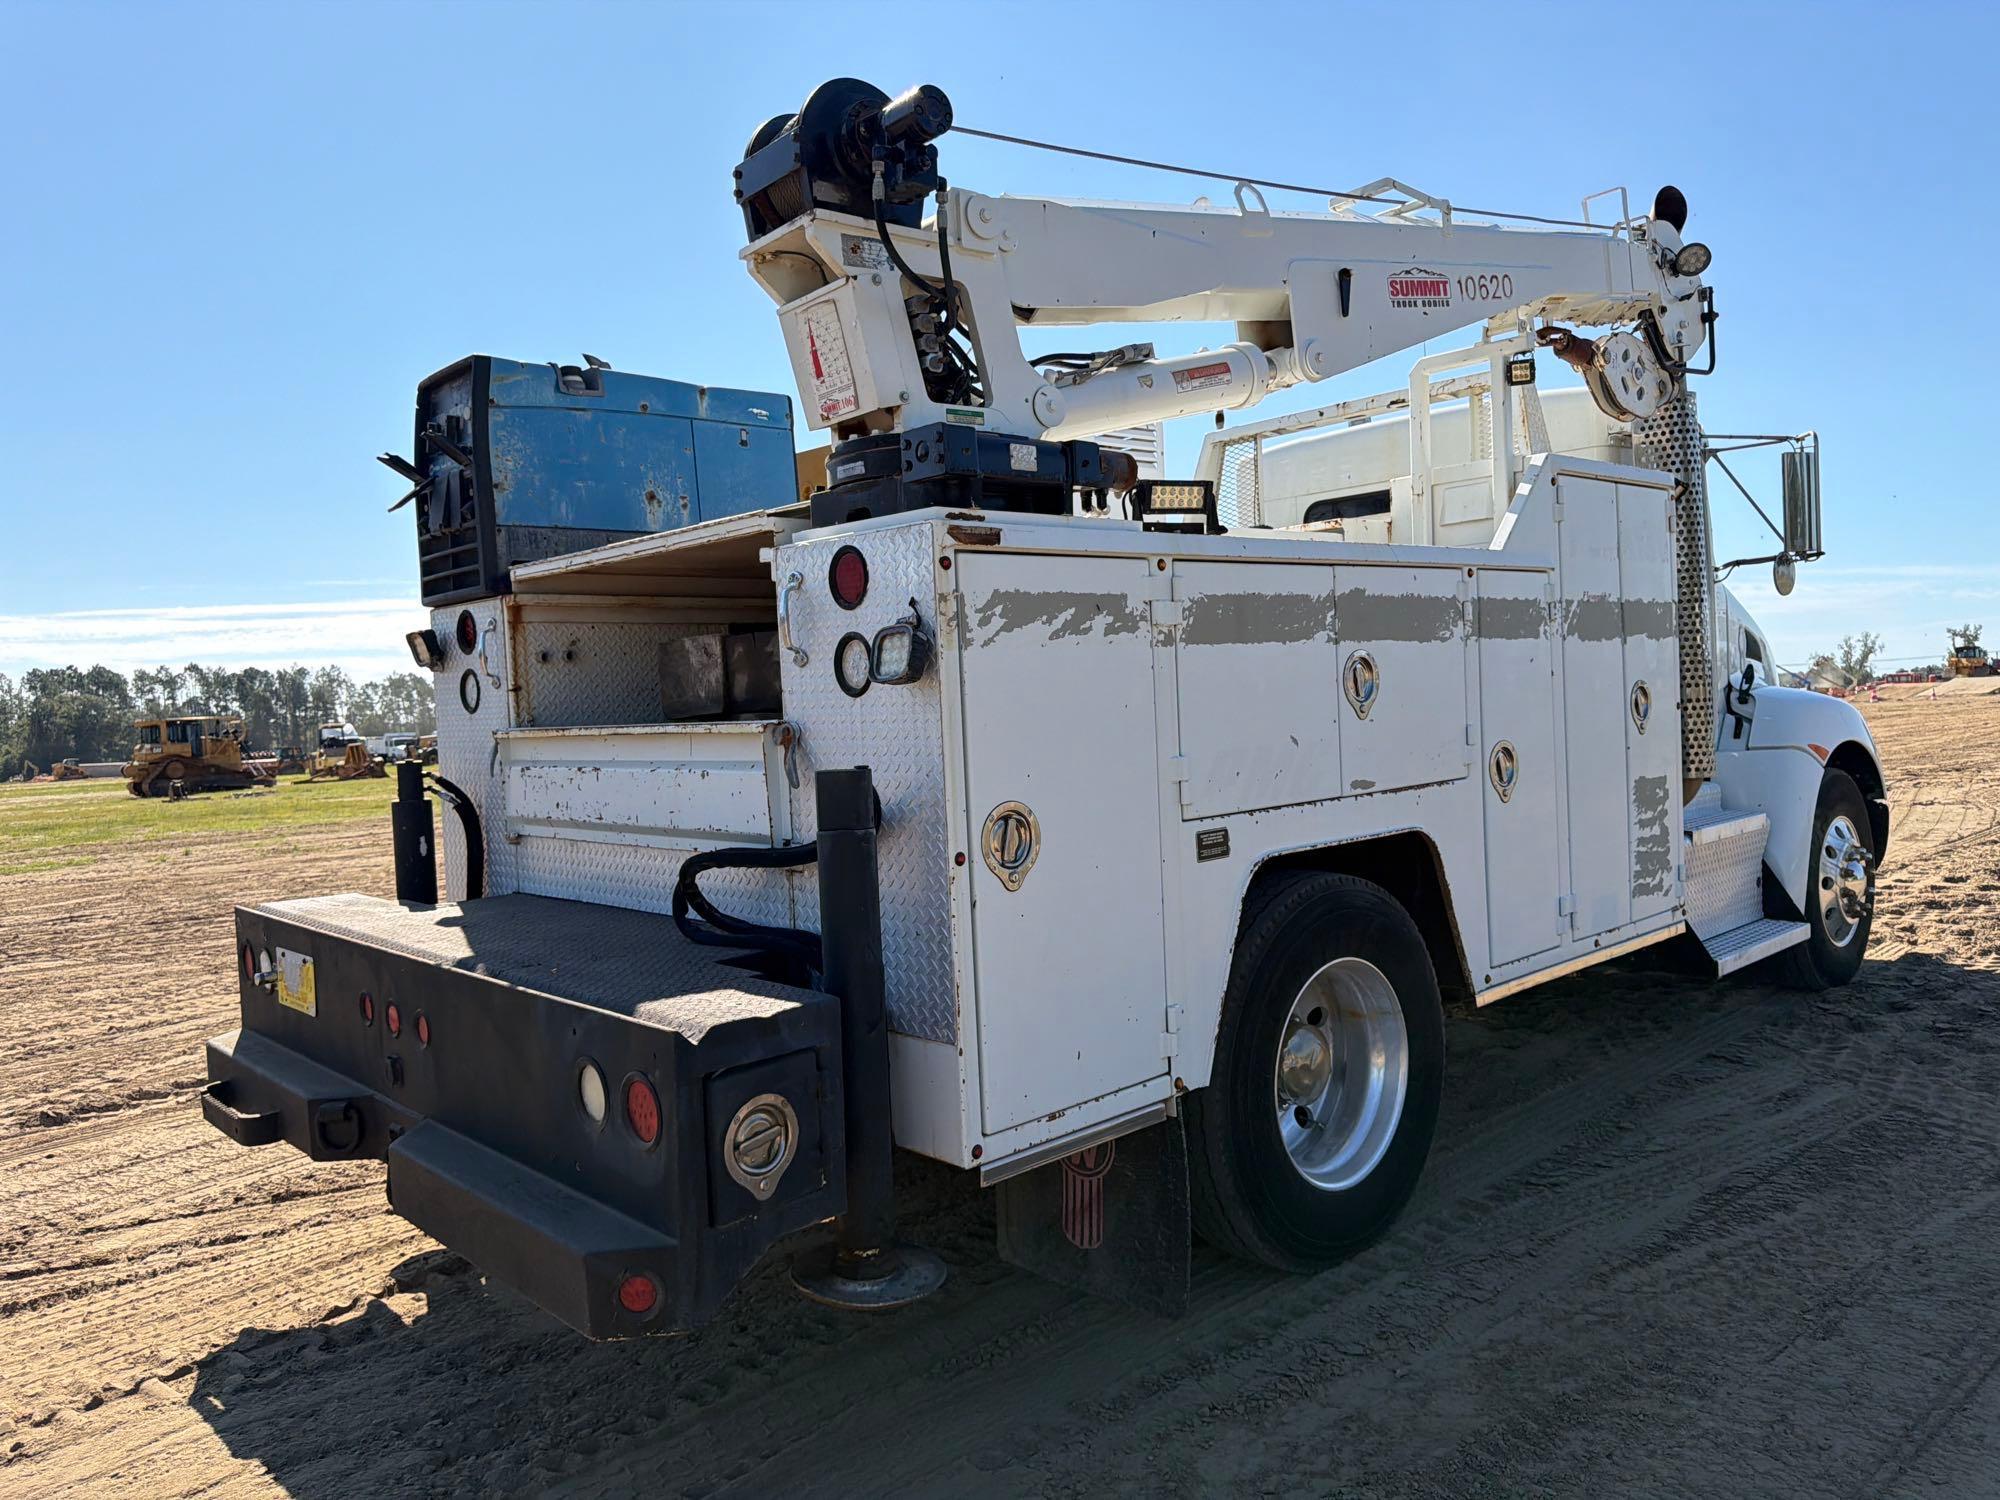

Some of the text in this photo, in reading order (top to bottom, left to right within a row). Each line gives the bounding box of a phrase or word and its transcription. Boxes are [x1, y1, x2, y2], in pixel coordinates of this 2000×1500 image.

[1389, 274, 1513, 302] SUMMIT 10620
[1391, 300, 1450, 308] TRUCK BODIES
